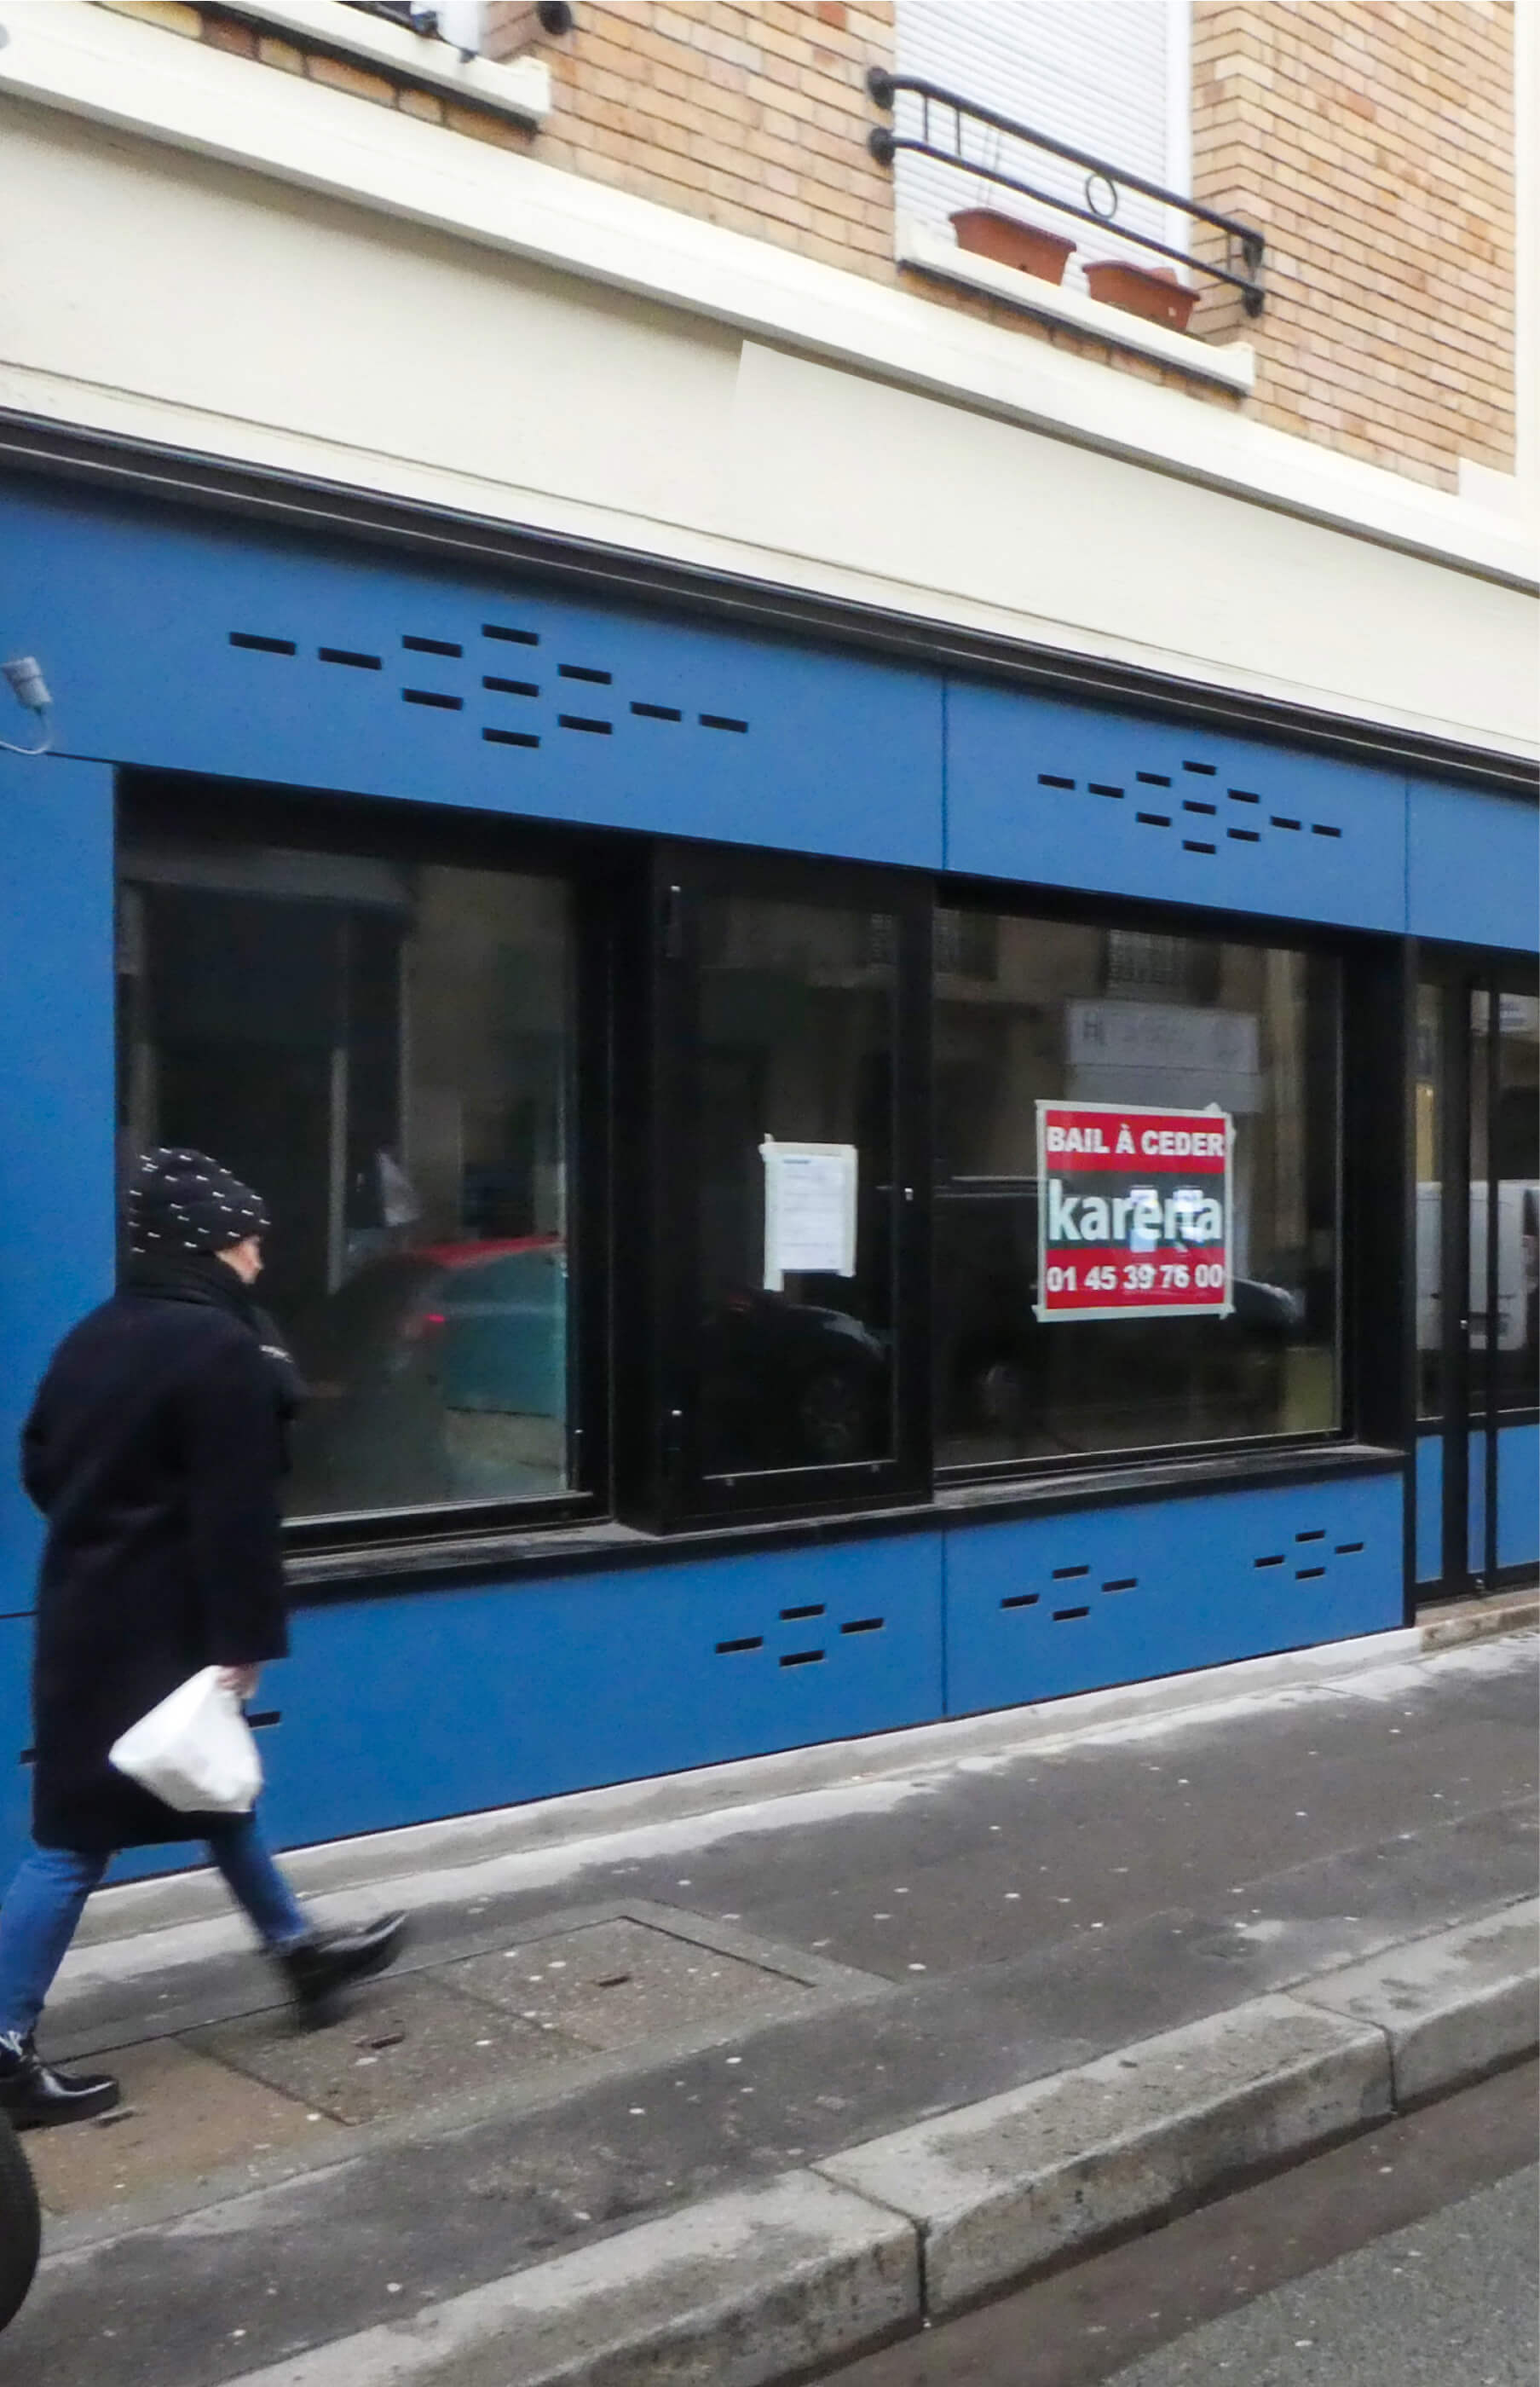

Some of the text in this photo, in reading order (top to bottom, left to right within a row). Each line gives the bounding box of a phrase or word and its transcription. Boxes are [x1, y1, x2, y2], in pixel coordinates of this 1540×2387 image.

[1047, 1123, 1225, 1157] BAIL À CEDER
[1047, 1267, 1077, 1292] 01
[1084, 1266, 1118, 1291] 45
[1122, 1263, 1156, 1290] 39
[1195, 1263, 1224, 1288] 00
